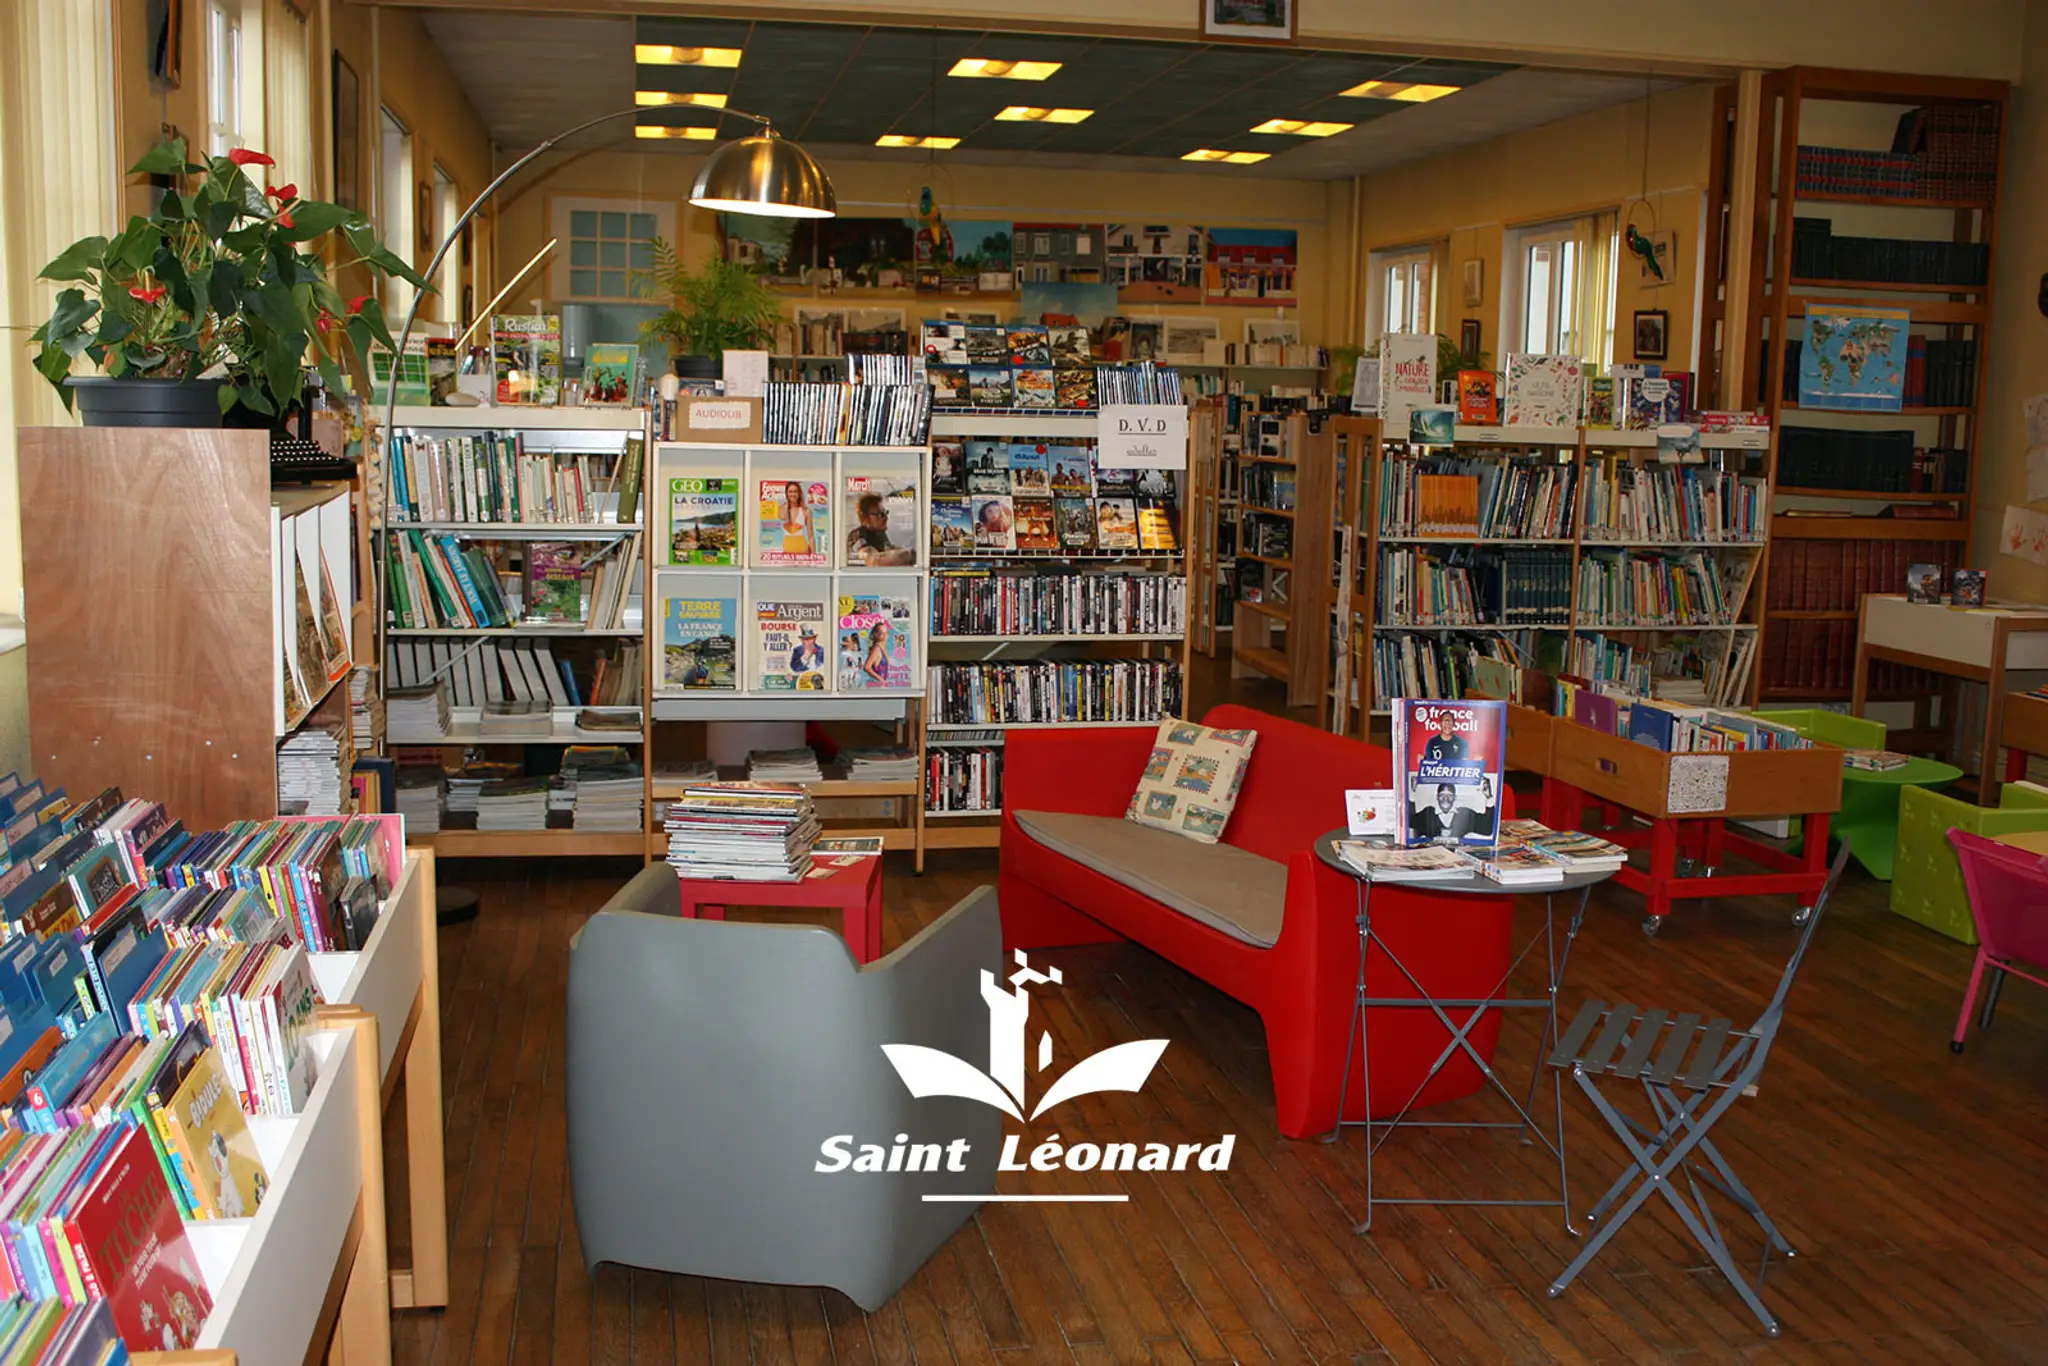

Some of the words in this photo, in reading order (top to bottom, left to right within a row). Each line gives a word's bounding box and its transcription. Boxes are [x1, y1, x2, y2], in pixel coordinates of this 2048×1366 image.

[1396, 362, 1430, 376] NATURE
[696, 409, 742, 419] AUDIOLIB
[672, 479, 703, 492] GEO
[675, 497, 689, 505] LA
[691, 497, 733, 505] CROATIE
[777, 604, 821, 620] Argent
[761, 622, 797, 630] BOURSE
[1425, 719, 1478, 731] foall
[1420, 765, 1480, 777] L'HÉRITIER
[33, 1092, 43, 1106] 6
